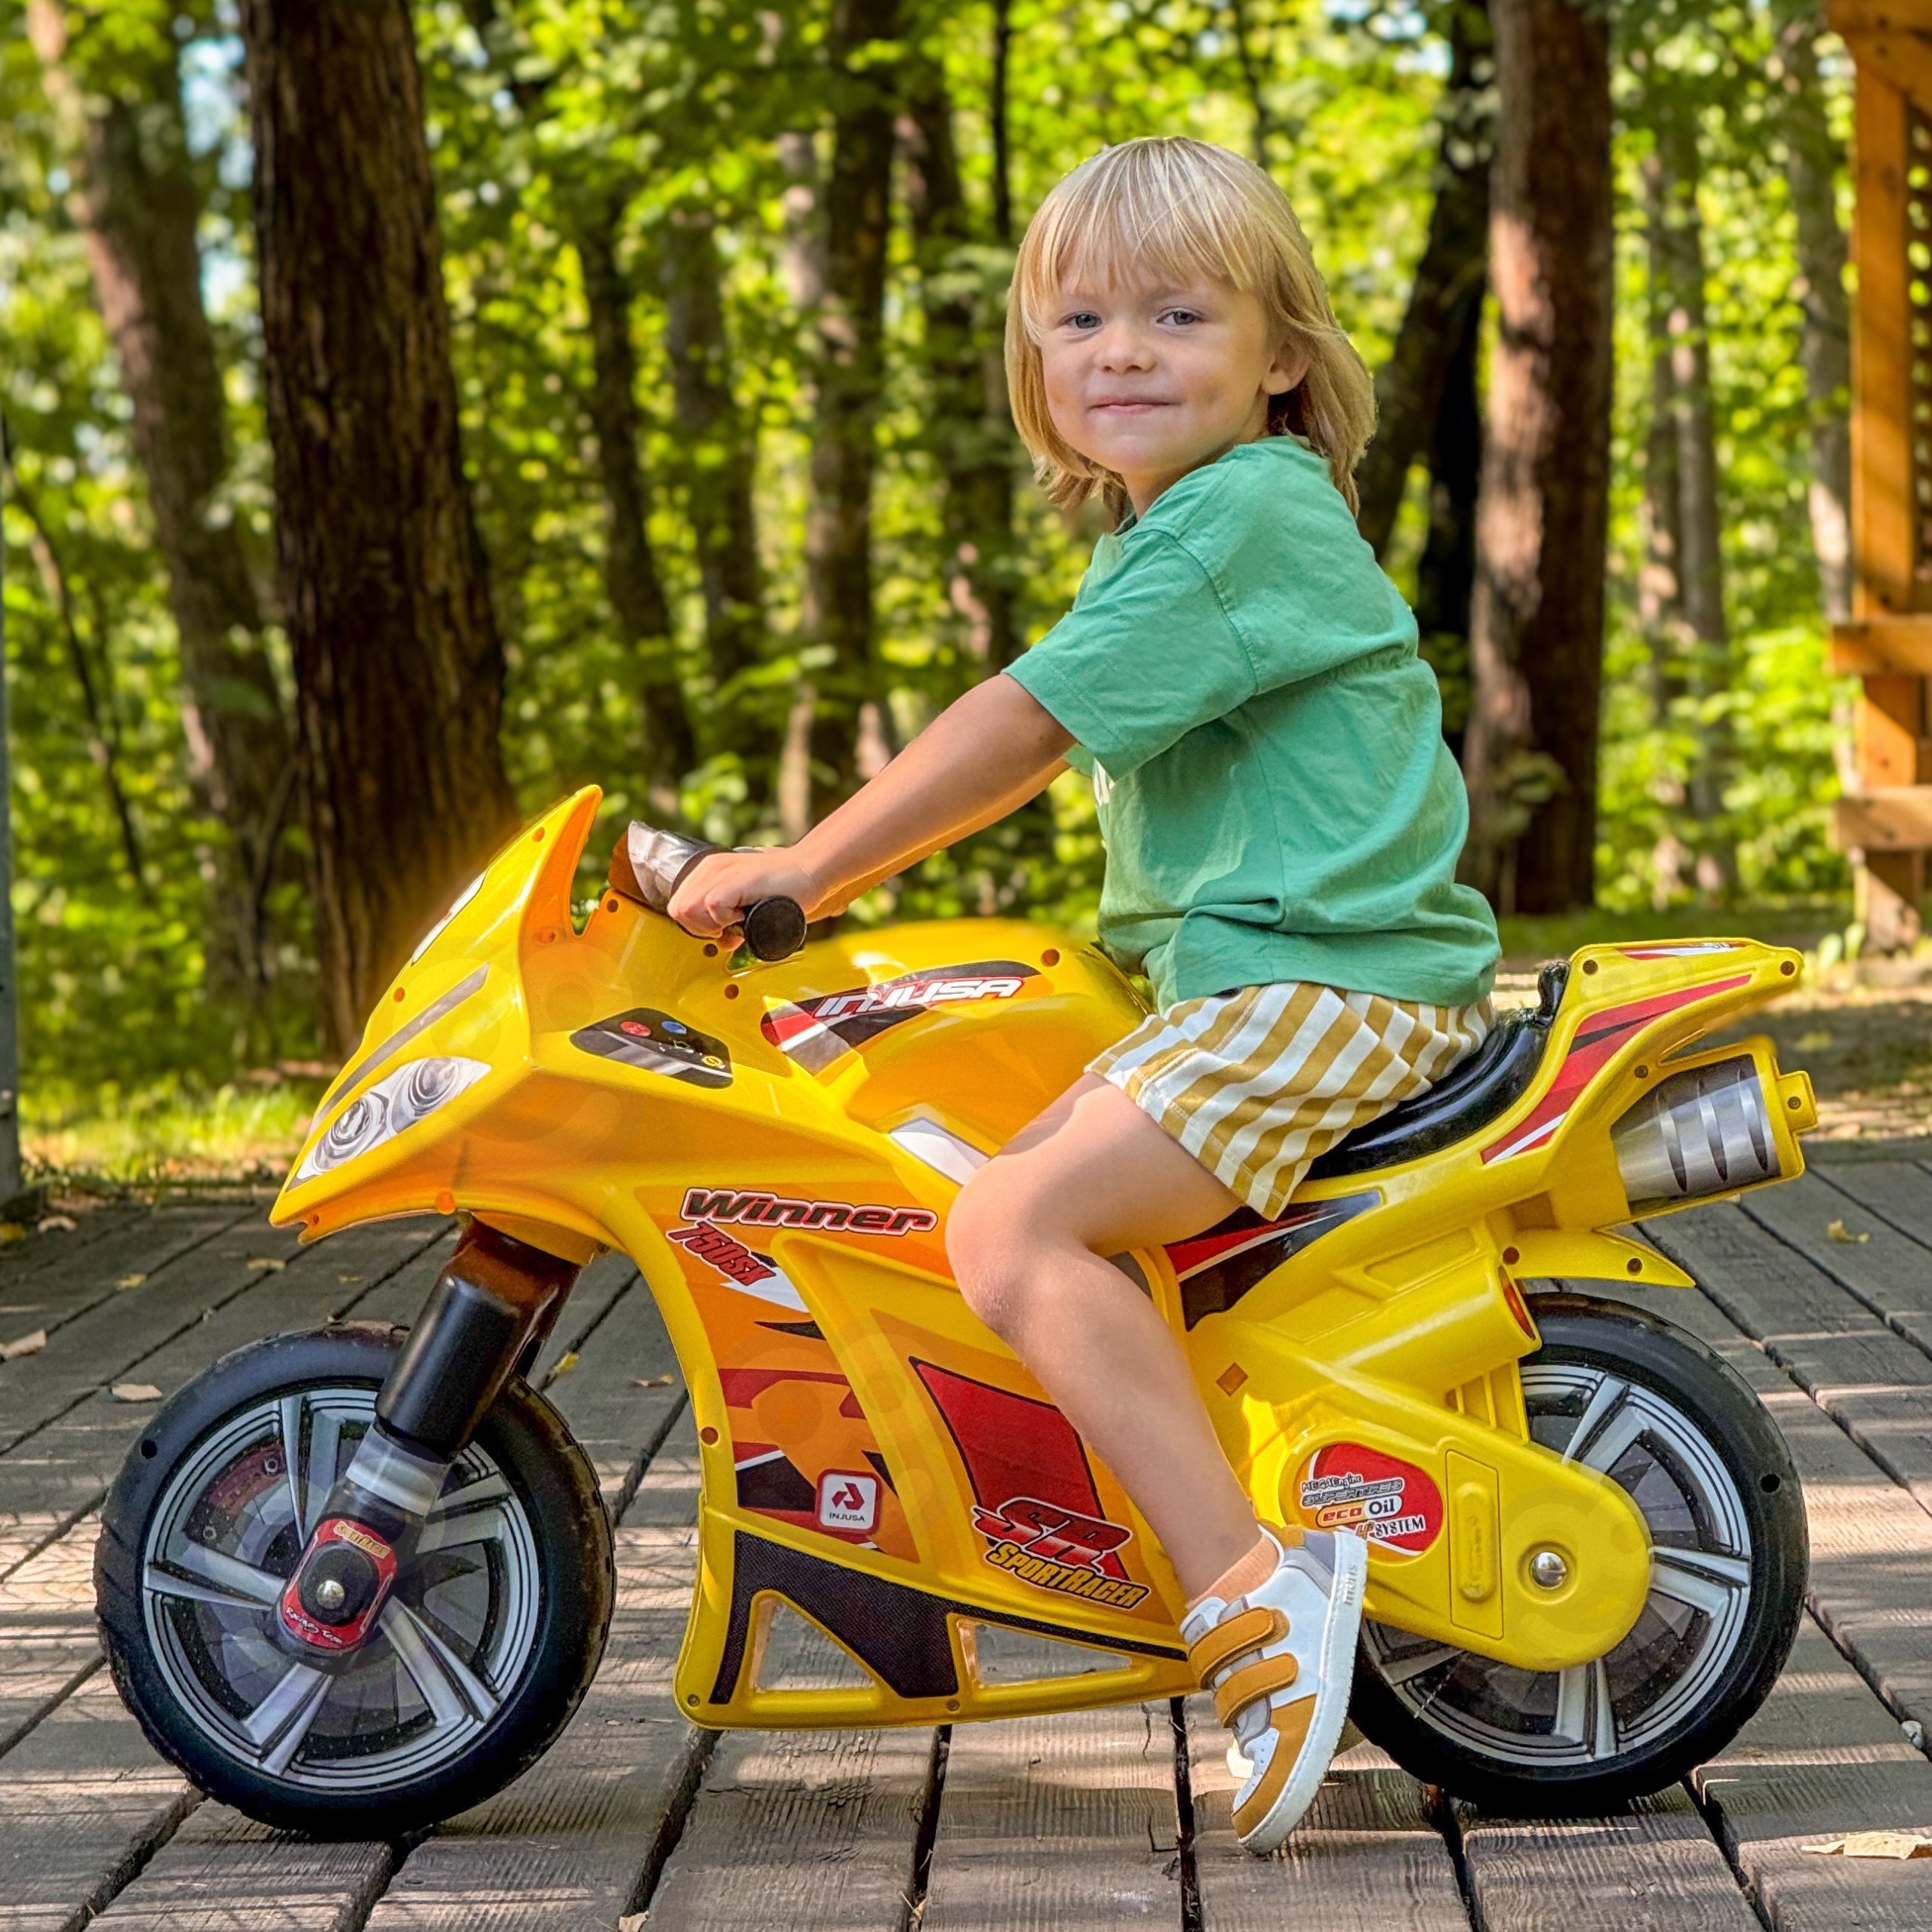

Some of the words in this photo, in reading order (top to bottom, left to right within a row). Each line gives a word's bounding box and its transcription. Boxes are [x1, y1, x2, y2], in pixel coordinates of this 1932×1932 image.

[813, 978, 1024, 1019] INJUSA
[684, 1191, 934, 1232] Winner
[829, 1512, 865, 1521] INJUSA
[1322, 1507, 1362, 1521] eco
[1368, 1498, 1395, 1515] Oil
[974, 1500, 1130, 1574] SR
[1375, 1517, 1424, 1537] SYSTEM
